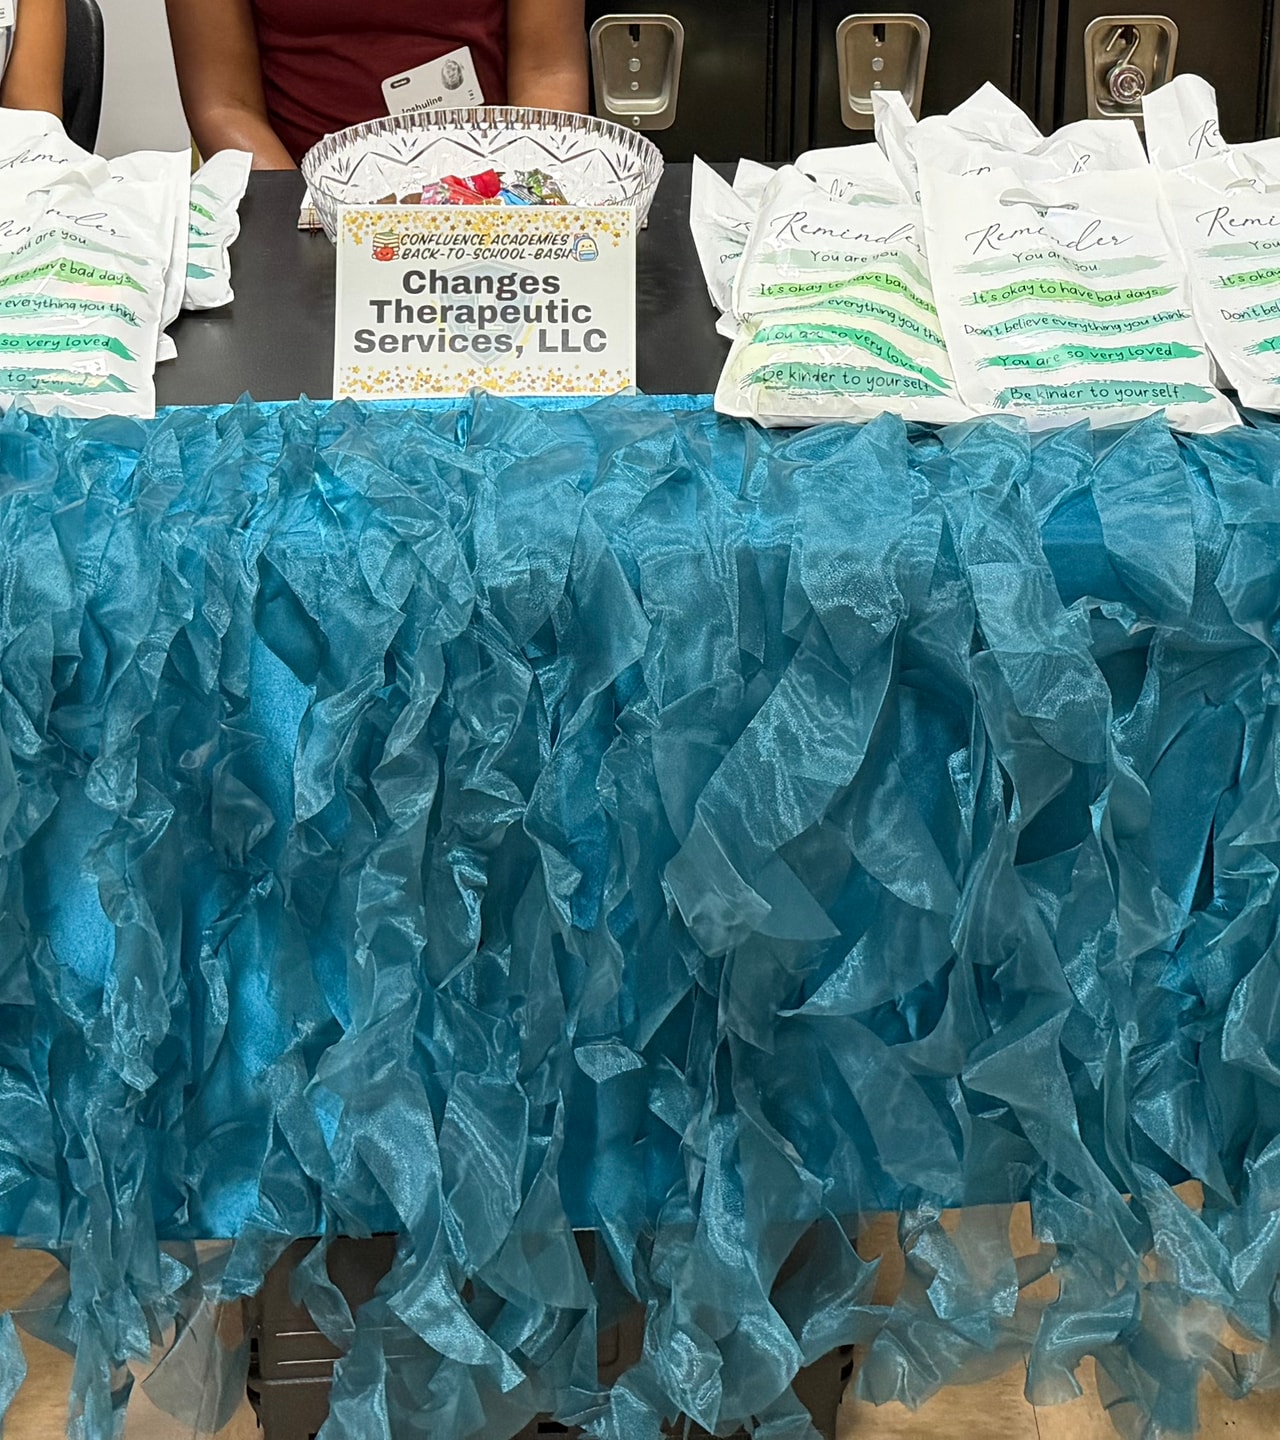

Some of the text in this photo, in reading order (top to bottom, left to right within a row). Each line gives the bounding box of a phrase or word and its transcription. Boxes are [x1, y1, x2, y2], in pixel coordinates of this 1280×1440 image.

[400, 233, 570, 247] CONFLUENCE ACADEMIES
[401, 248, 573, 260] BACK-TO-SCHOOL-BASH
[1012, 251, 1043, 263] You
[402, 268, 561, 301] Changes
[972, 291, 998, 304] It's
[1002, 283, 1034, 299] okay
[1039, 283, 1055, 294] to
[1059, 282, 1093, 299] have
[1097, 291, 1121, 302] bad
[369, 298, 593, 331] Therapeutic
[965, 324, 1001, 336] Don't
[1005, 317, 1048, 332] believe
[1052, 318, 1122, 333] everything
[1123, 320, 1149, 331] you
[2, 338, 20, 348] so
[27, 337, 61, 351] very
[353, 327, 608, 359] Services, LLC
[998, 355, 1030, 366] You
[1036, 354, 1060, 365] are
[1067, 350, 1084, 359] so
[1090, 352, 1124, 360] very
[1010, 387, 1031, 400] Be
[1037, 388, 1083, 399] kinder
[1091, 388, 1109, 398] to
